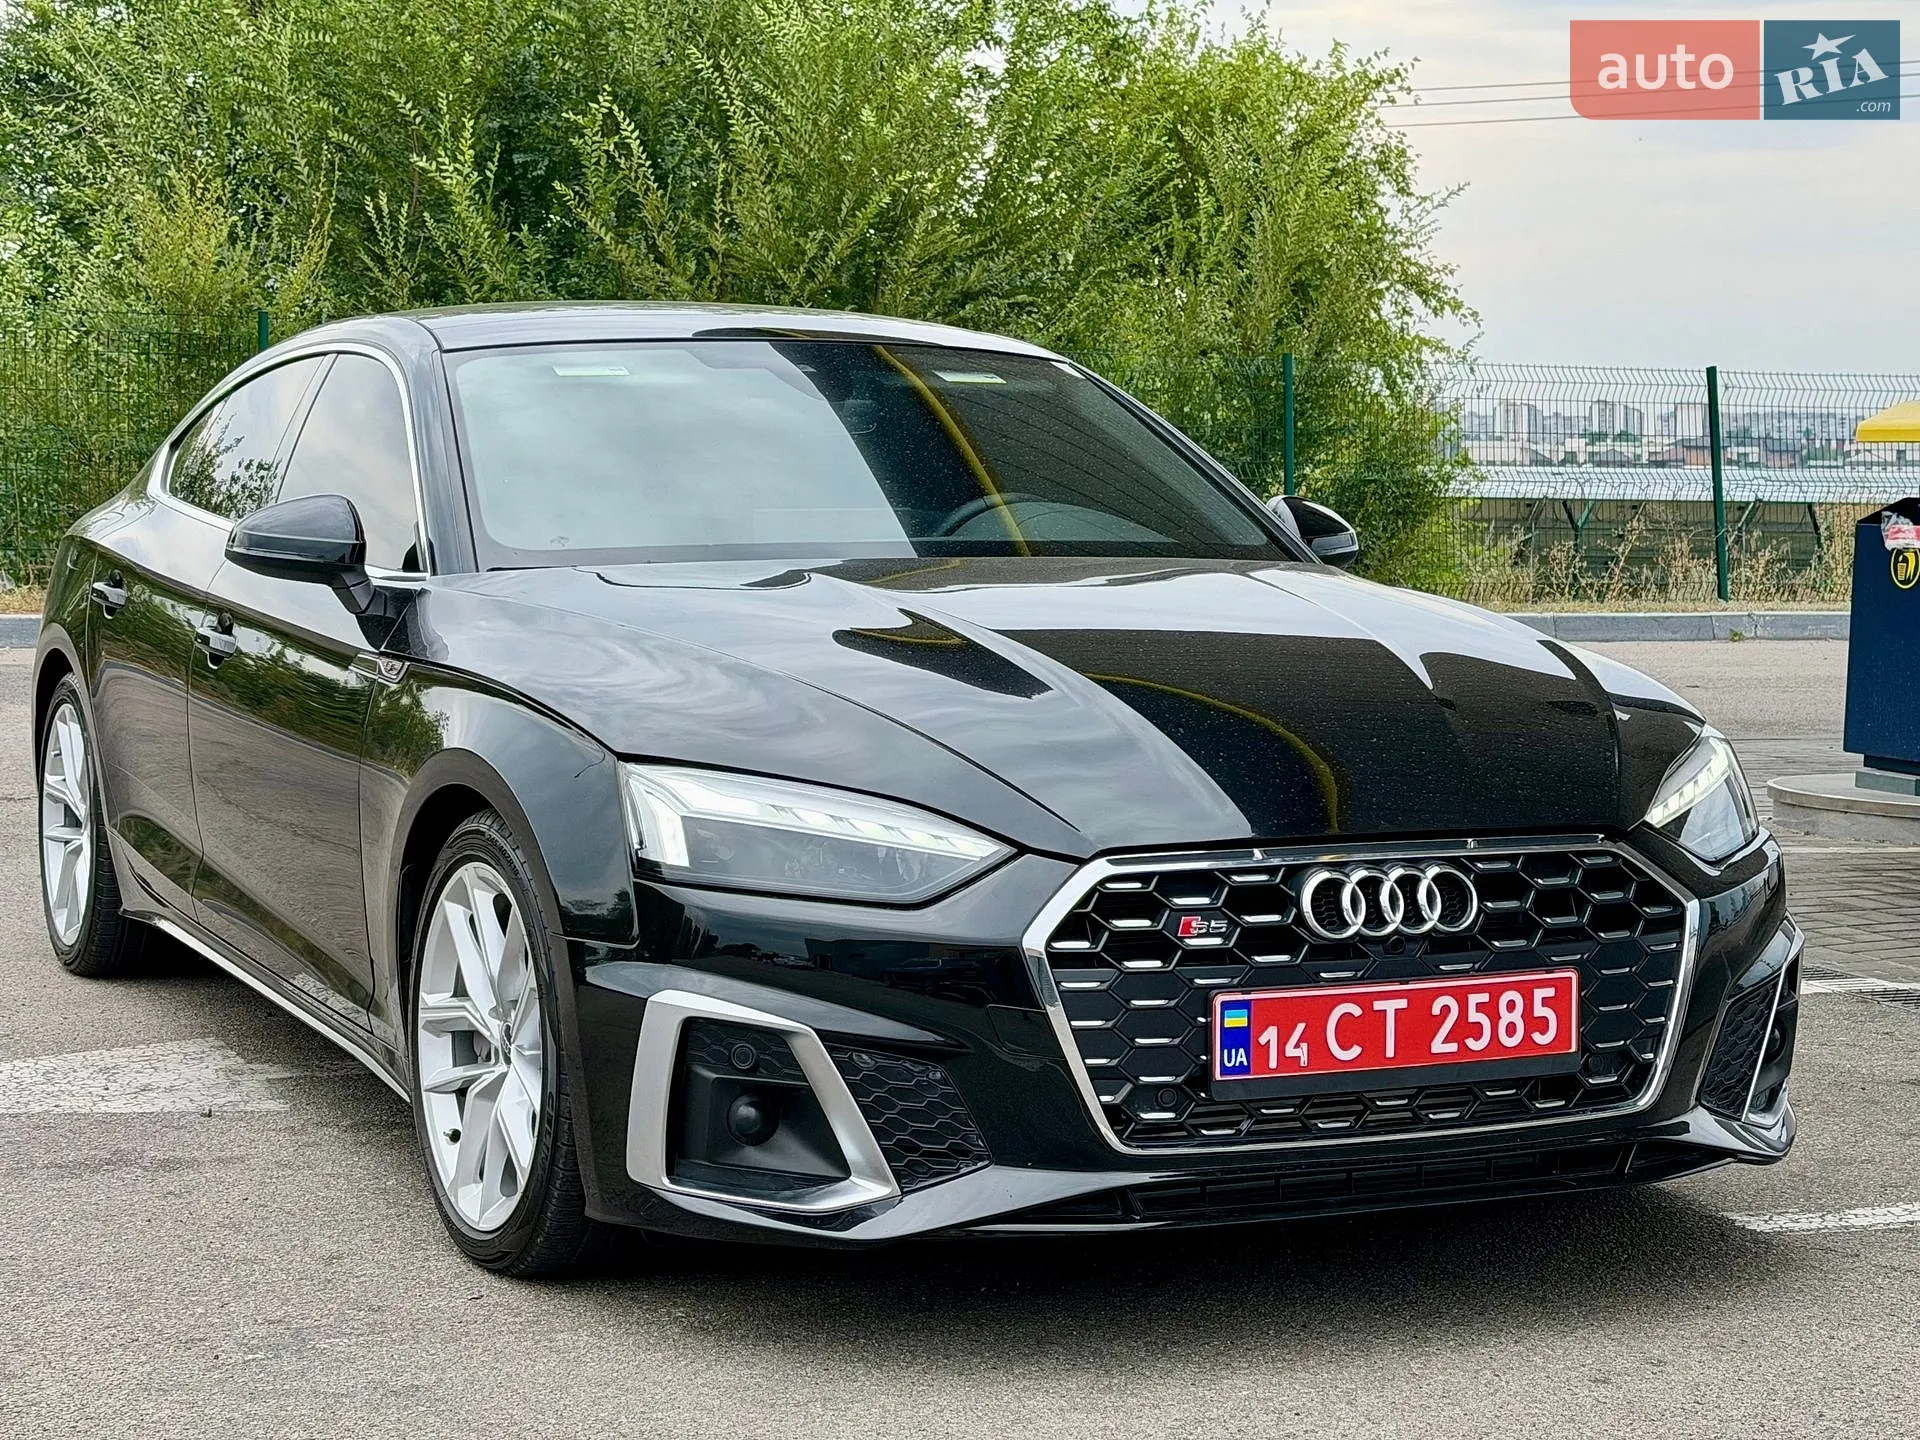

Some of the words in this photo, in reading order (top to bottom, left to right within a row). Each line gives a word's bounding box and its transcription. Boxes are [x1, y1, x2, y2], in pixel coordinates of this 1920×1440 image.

[1188, 919, 1228, 934] S5
[1257, 1022, 1309, 1069] 14
[1325, 998, 1409, 1061] CT
[1430, 987, 1558, 1055] 2585
[1223, 1048, 1248, 1067] UA
